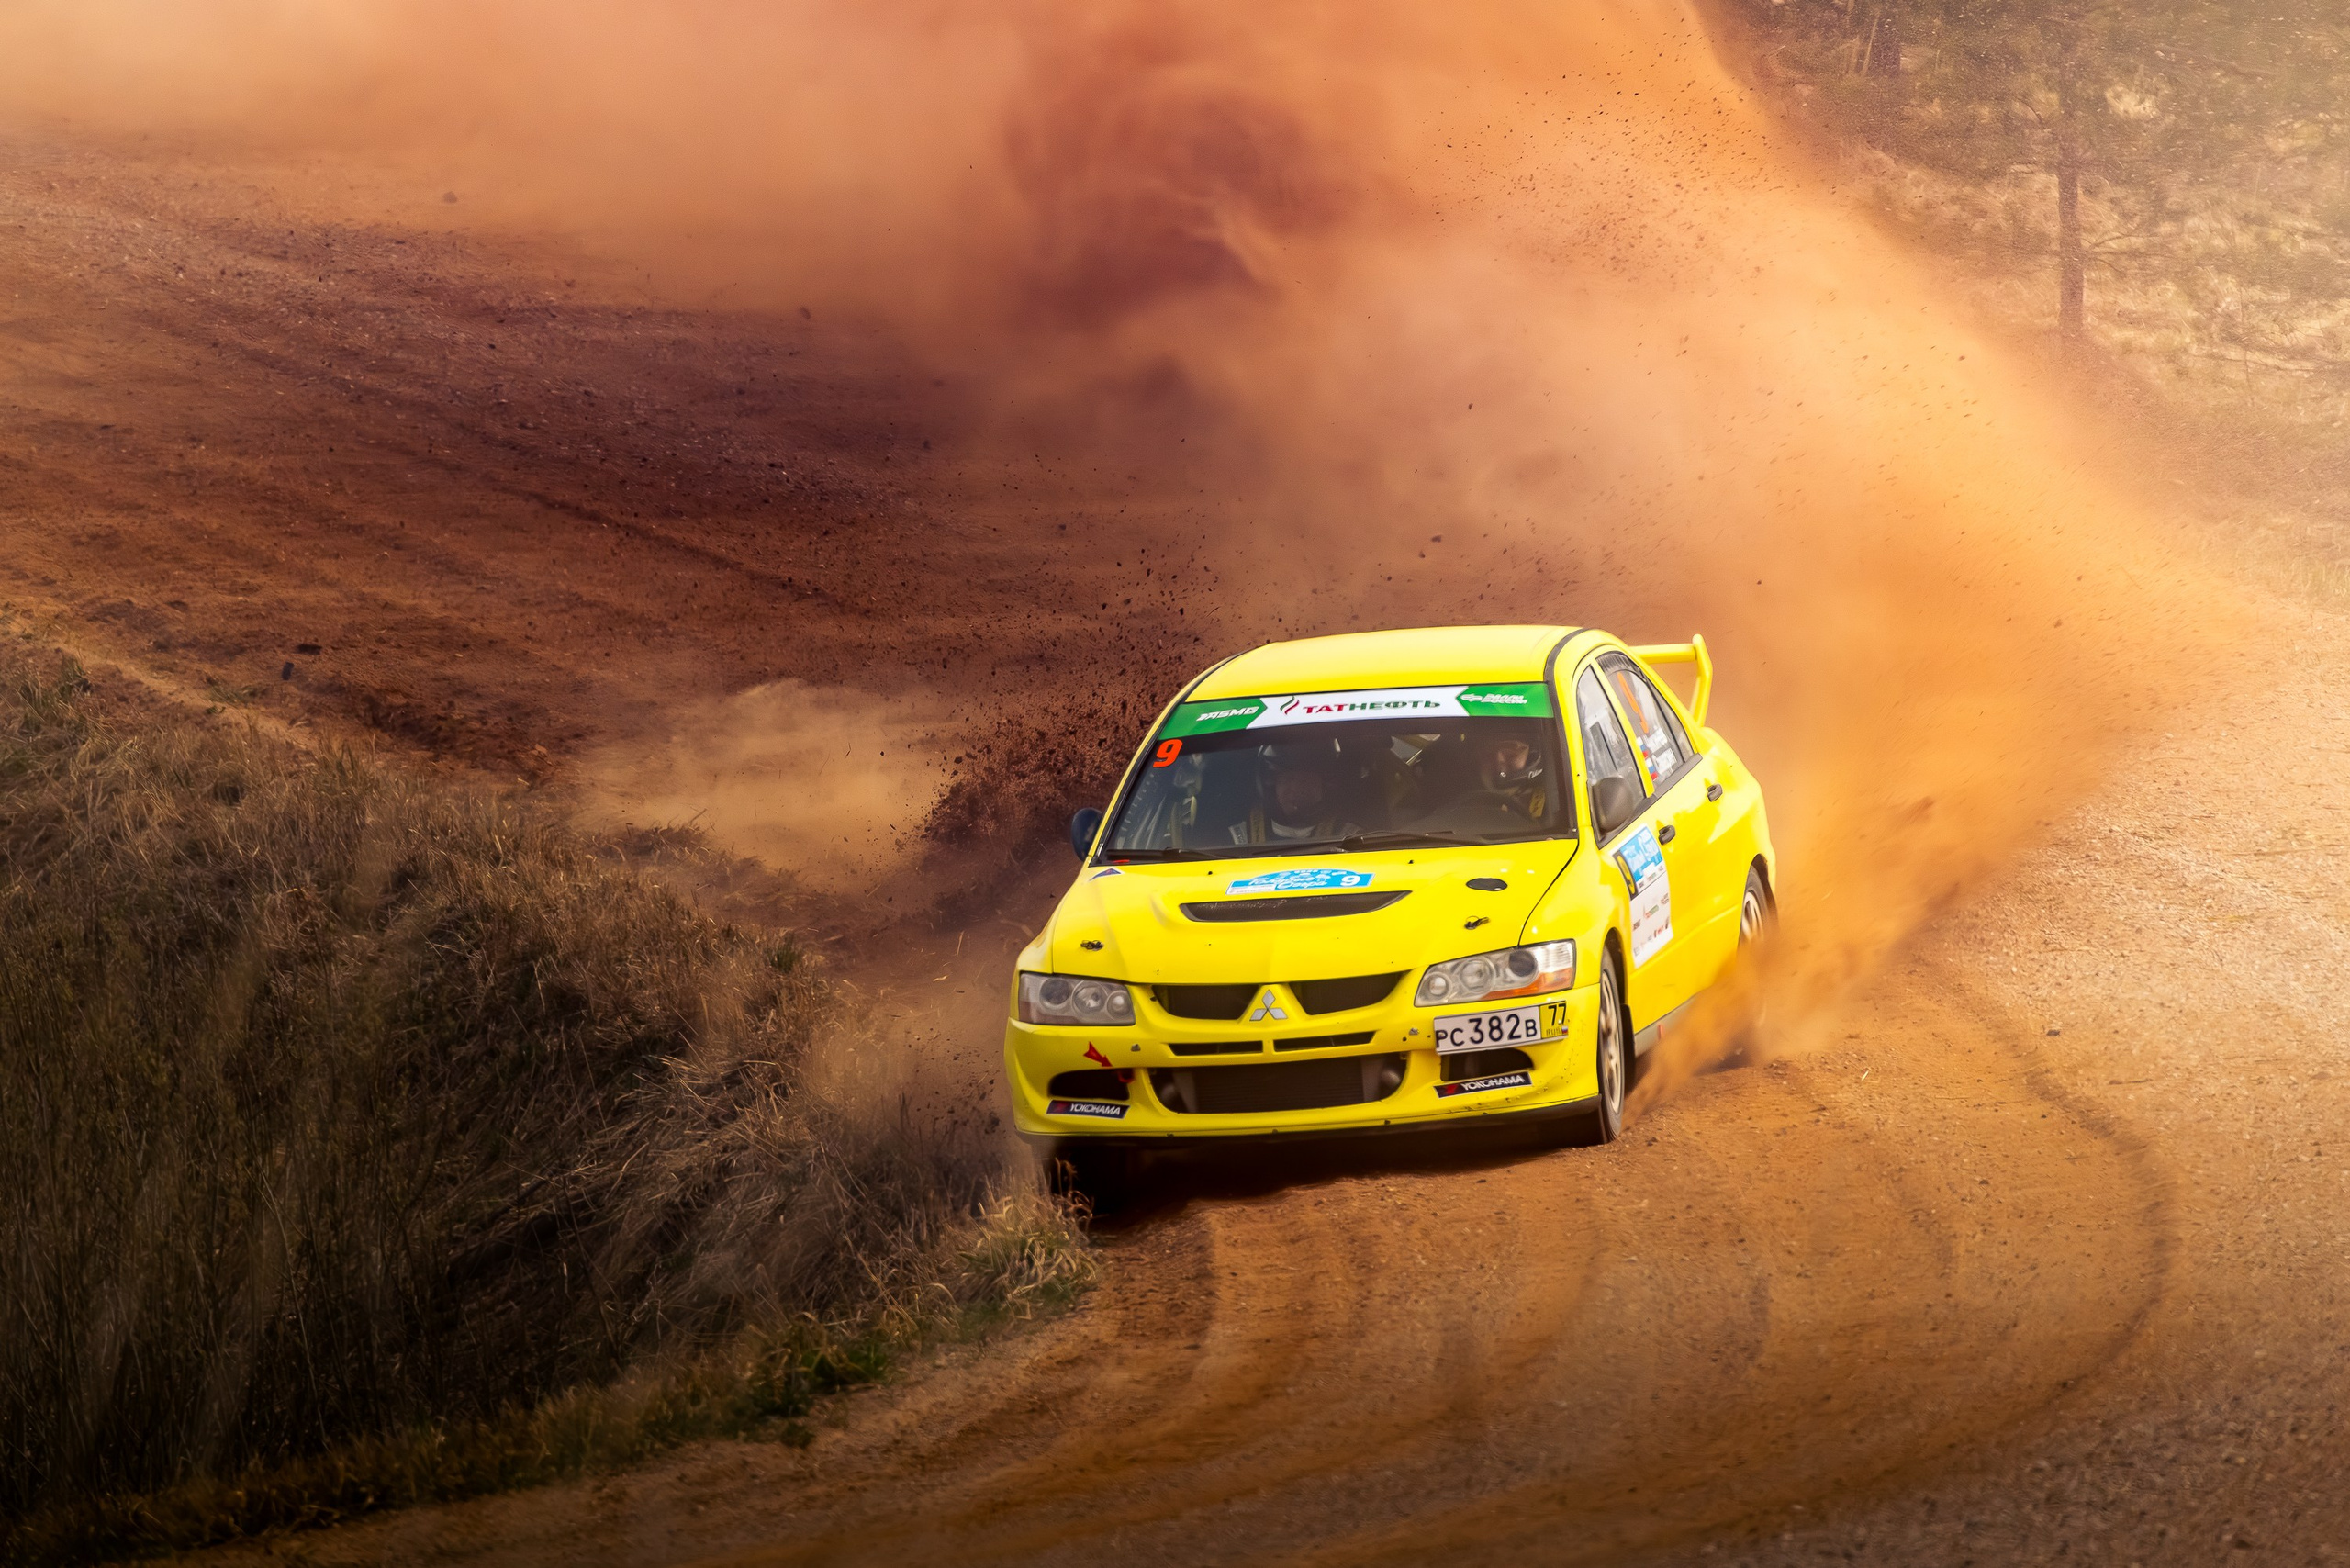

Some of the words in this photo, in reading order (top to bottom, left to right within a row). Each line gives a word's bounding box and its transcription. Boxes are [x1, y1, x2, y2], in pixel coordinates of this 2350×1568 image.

[1303, 700, 1441, 714] ТАТНЕФТЬ
[1152, 738, 1183, 768] 9
[1339, 875, 1361, 887] 9
[1548, 1002, 1567, 1026] 77
[1460, 1074, 1526, 1092] YOKOHAMA
[1069, 1103, 1121, 1116] YOKOHAMA
